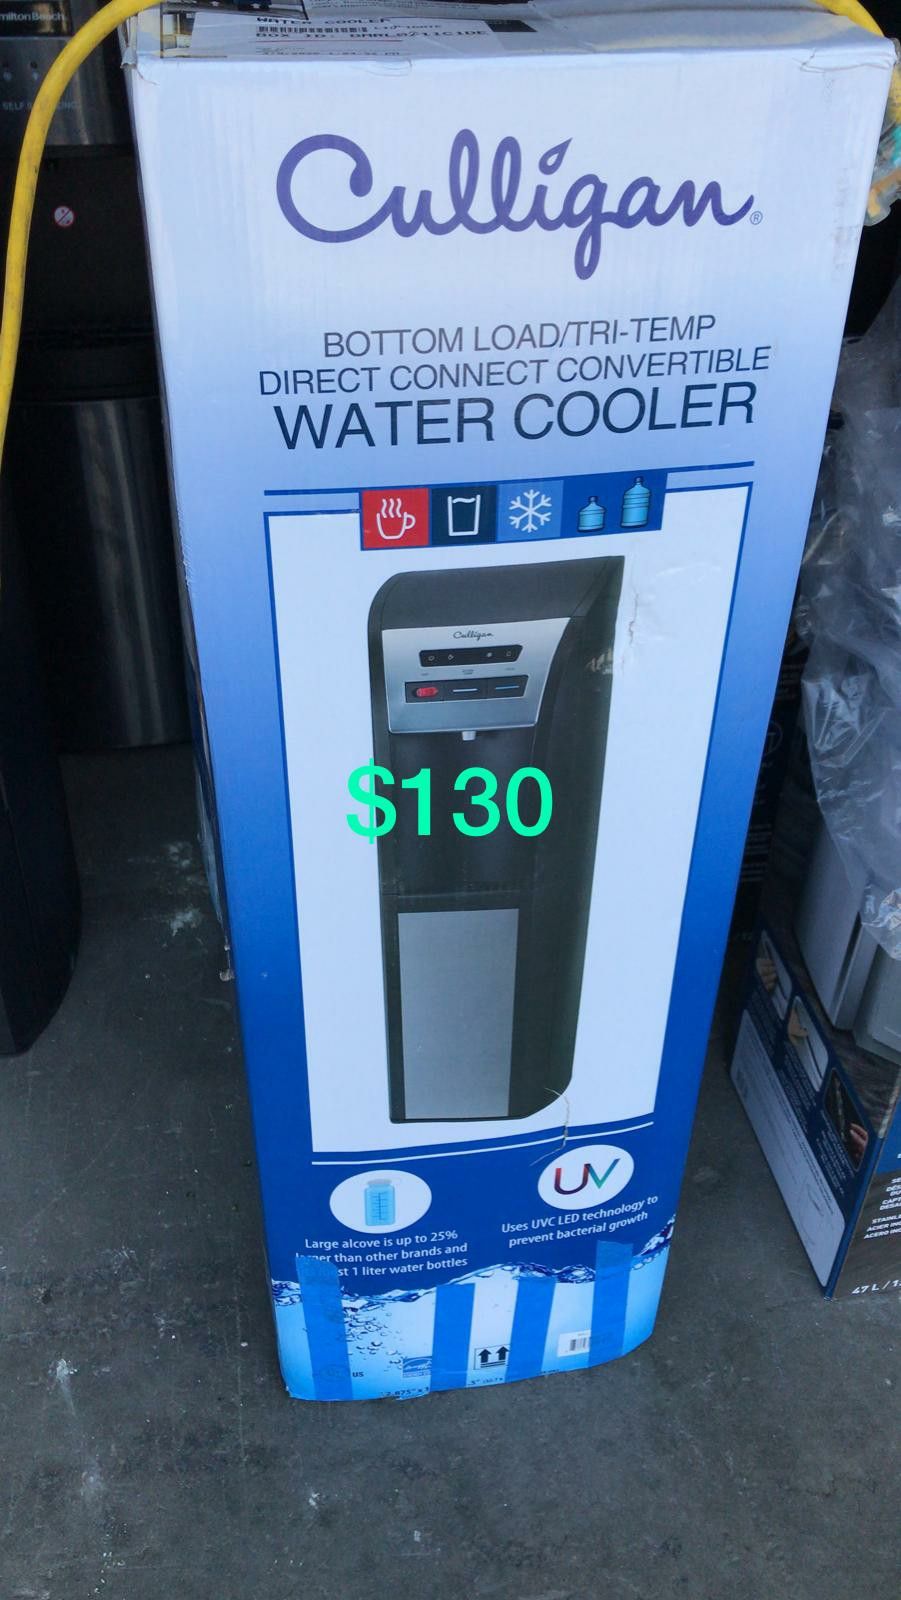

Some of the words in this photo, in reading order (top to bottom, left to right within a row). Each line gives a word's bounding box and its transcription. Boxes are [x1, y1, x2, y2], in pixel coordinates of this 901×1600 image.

[324, 327, 463, 358] BOTTOM
[474, 315, 716, 351] LOAD/TRI-TEMP
[259, 367, 381, 396] DIRECT
[390, 359, 549, 391] CONNECT
[557, 346, 772, 383] CONVERTIBLE
[273, 397, 495, 450] WATER
[514, 381, 757, 440] COOLER
[453, 630, 494, 641] Culligan
[554, 1158, 621, 1195] UV
[501, 1222, 529, 1233] Uses
[532, 1217, 556, 1229] UVC
[558, 1213, 580, 1226] LED
[583, 1200, 645, 1221] technology
[647, 1195, 659, 1205] to
[509, 1233, 554, 1248] prevent
[557, 1224, 607, 1240] bacterial
[609, 1212, 649, 1231] growth
[305, 1238, 339, 1251] Large
[342, 1238, 381, 1249] alcove
[384, 1237, 393, 1247] is
[396, 1236, 412, 1248] up
[415, 1234, 428, 1244] to
[430, 1229, 459, 1242] 25%
[334, 1252, 363, 1263] than
[365, 1251, 399, 1263] other
[401, 1246, 443, 1260] brands
[444, 1242, 469, 1254] and
[352, 1267, 358, 1276] 1
[362, 1265, 387, 1276] liter
[388, 1262, 424, 1274] water
[426, 1257, 469, 1271] bottles
